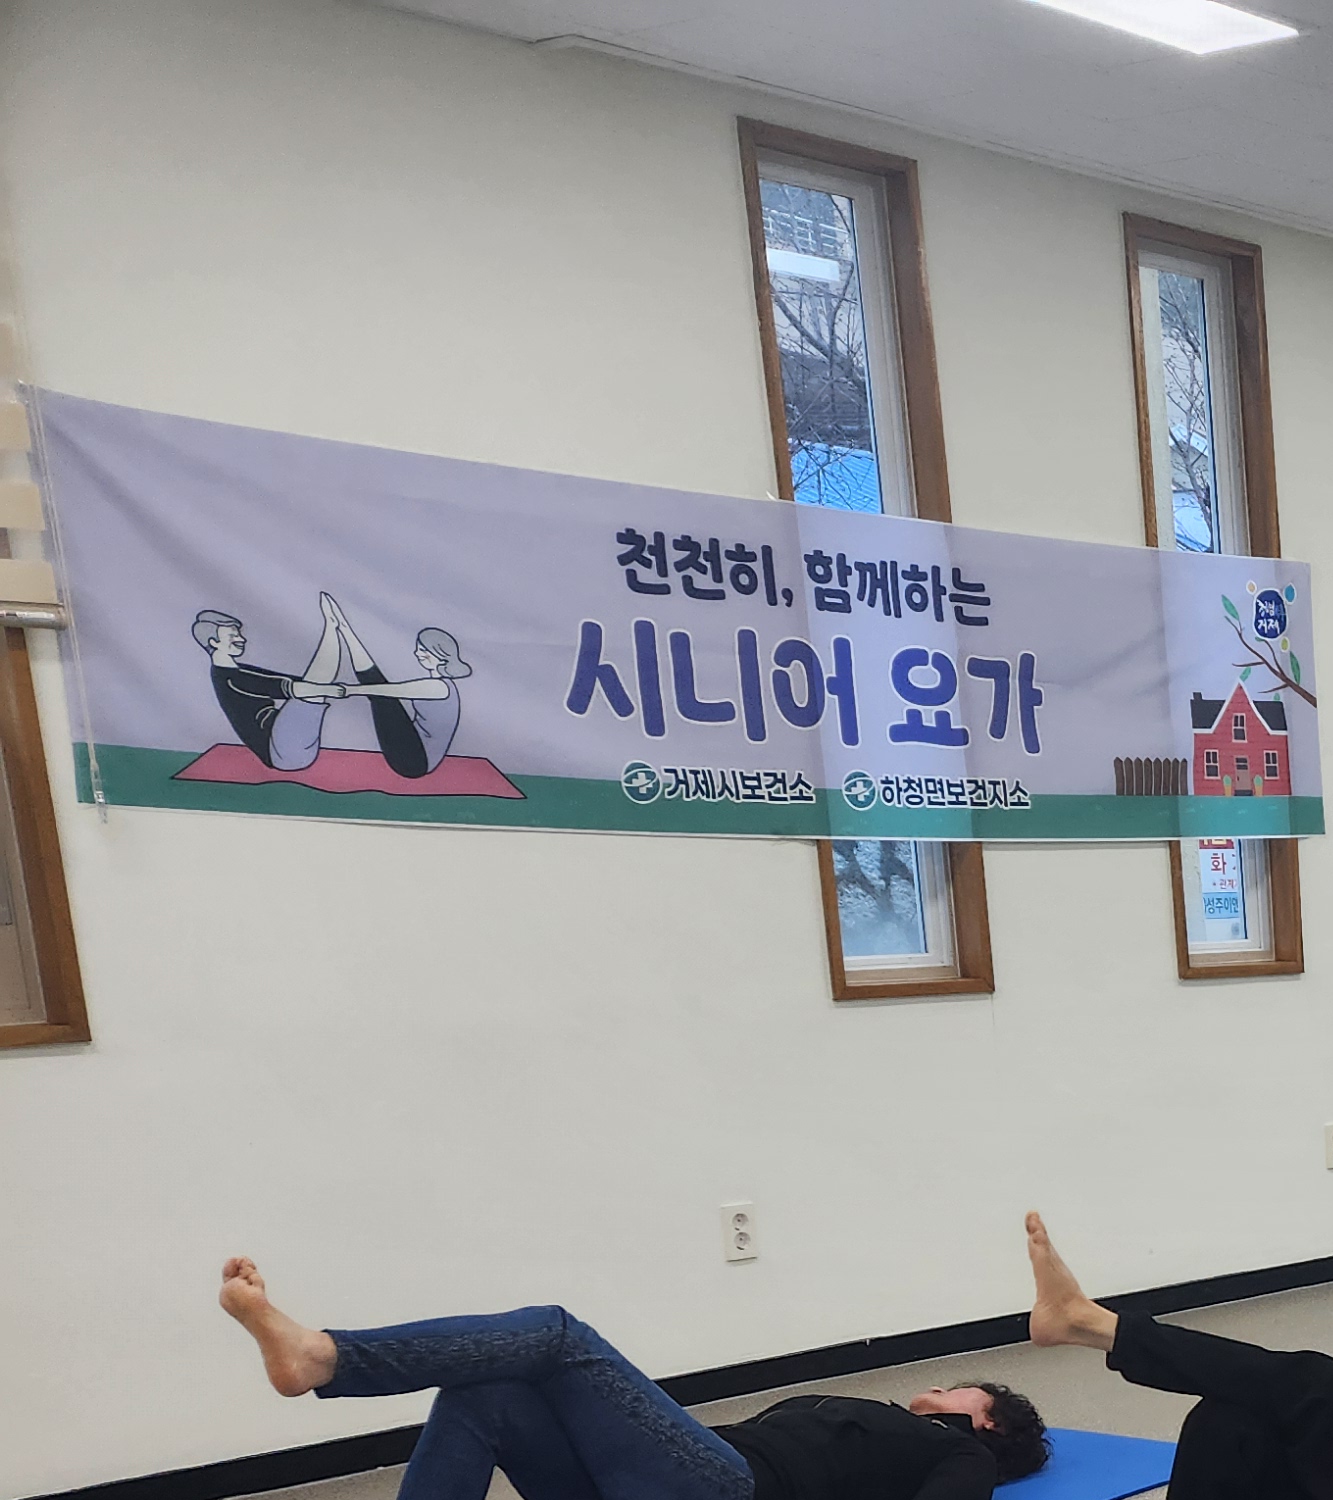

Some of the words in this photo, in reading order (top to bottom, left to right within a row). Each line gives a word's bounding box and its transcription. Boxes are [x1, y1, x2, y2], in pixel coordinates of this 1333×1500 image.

[616, 527, 793, 607] 천천히,
[803, 549, 991, 627] 함께하는
[565, 618, 861, 747] 시니어
[887, 646, 1043, 755] 요가
[662, 767, 816, 804] 거제시보건소
[879, 775, 1031, 809] 하청면보건지소
[1210, 852, 1236, 875] 화
